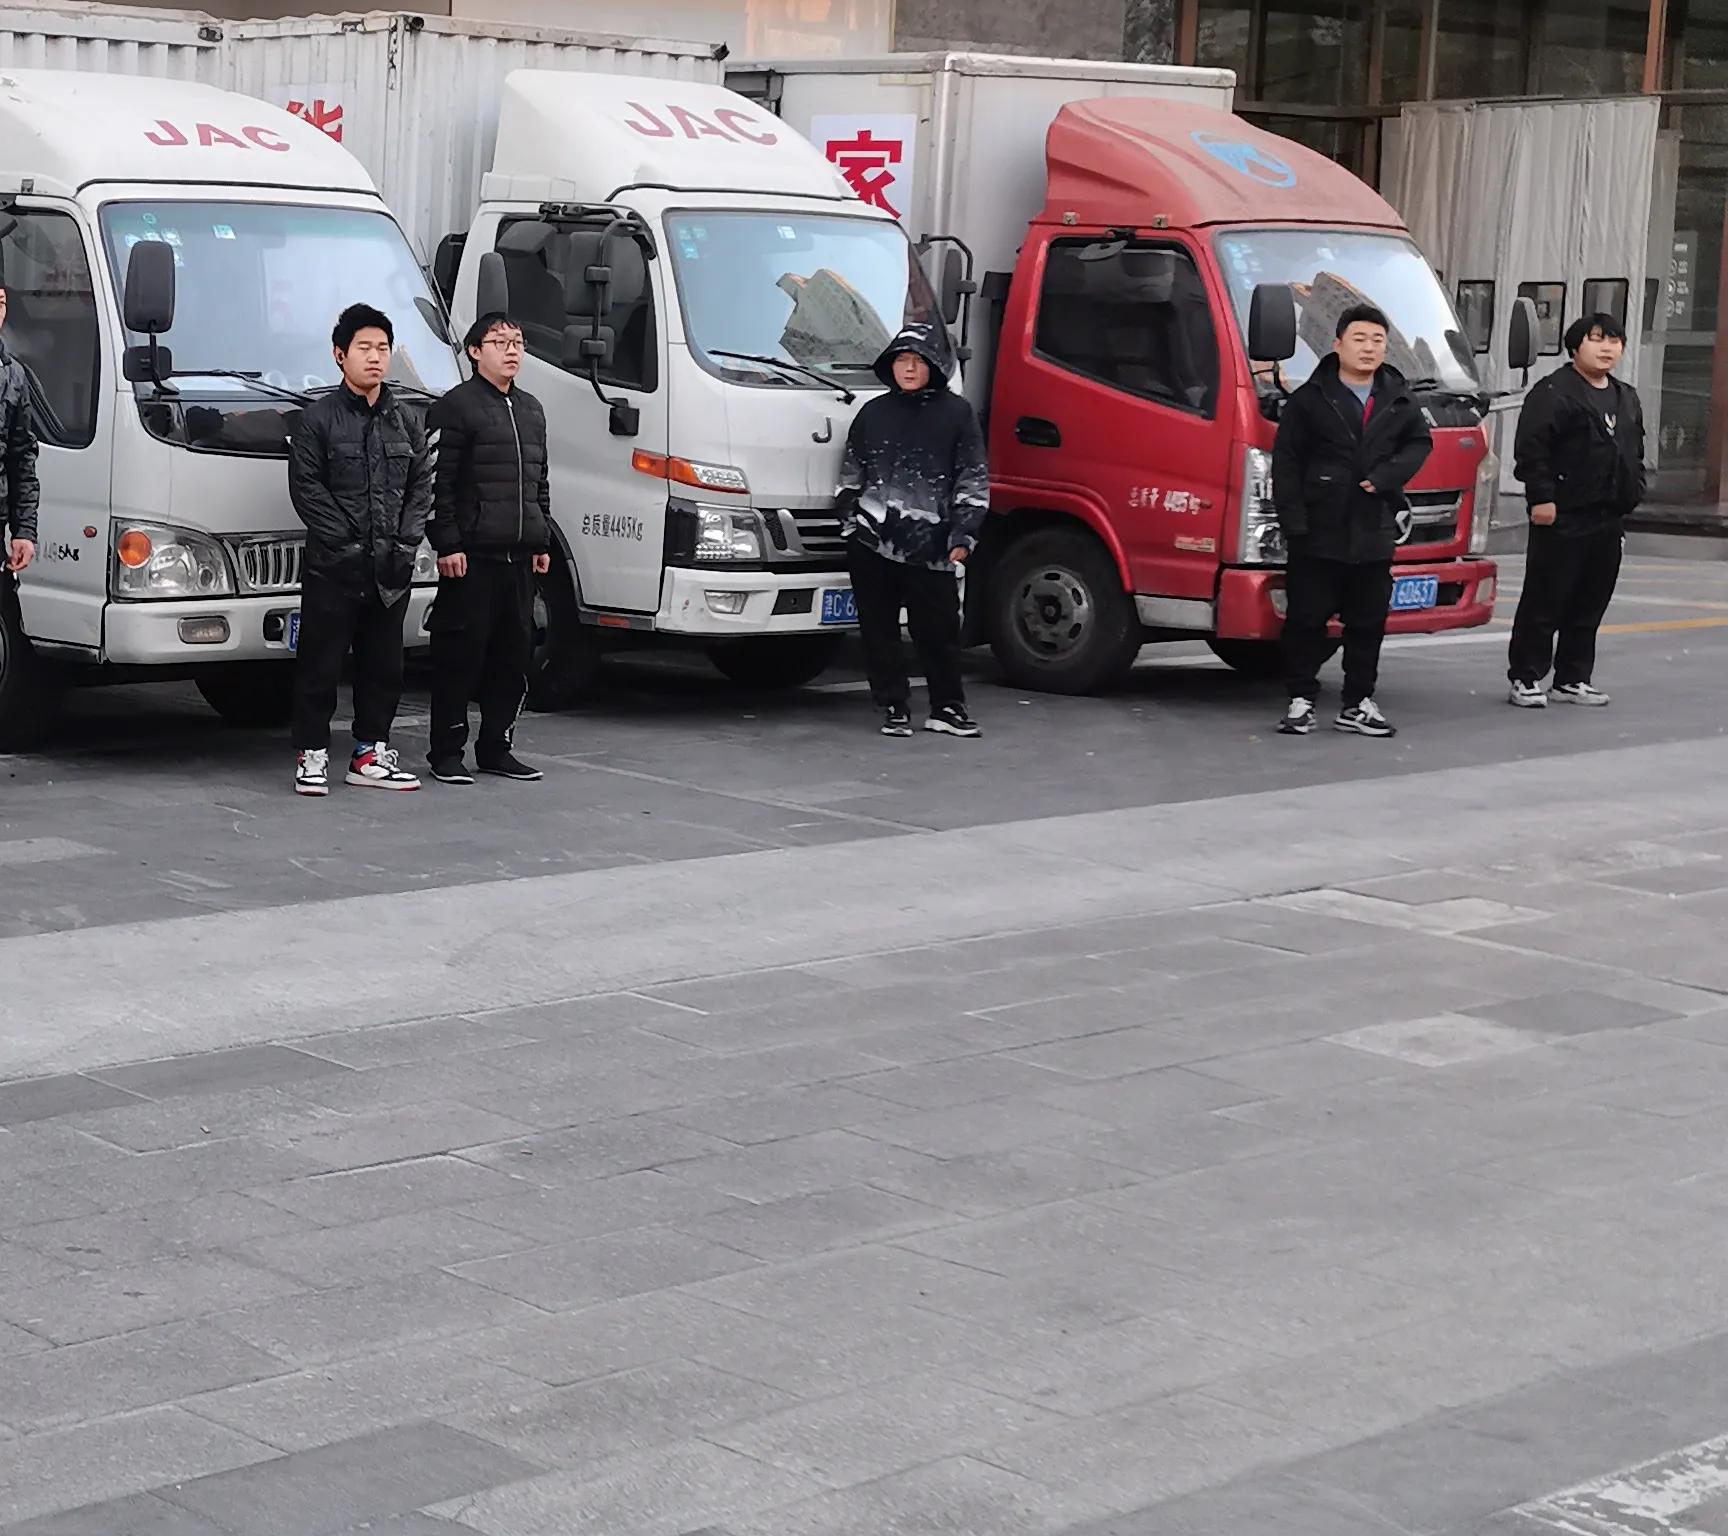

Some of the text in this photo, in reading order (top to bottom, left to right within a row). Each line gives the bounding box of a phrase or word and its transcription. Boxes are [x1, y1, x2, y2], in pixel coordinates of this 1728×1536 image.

[143, 119, 291, 152] JAC
[624, 101, 778, 146] JAC
[825, 129, 904, 221] 家
